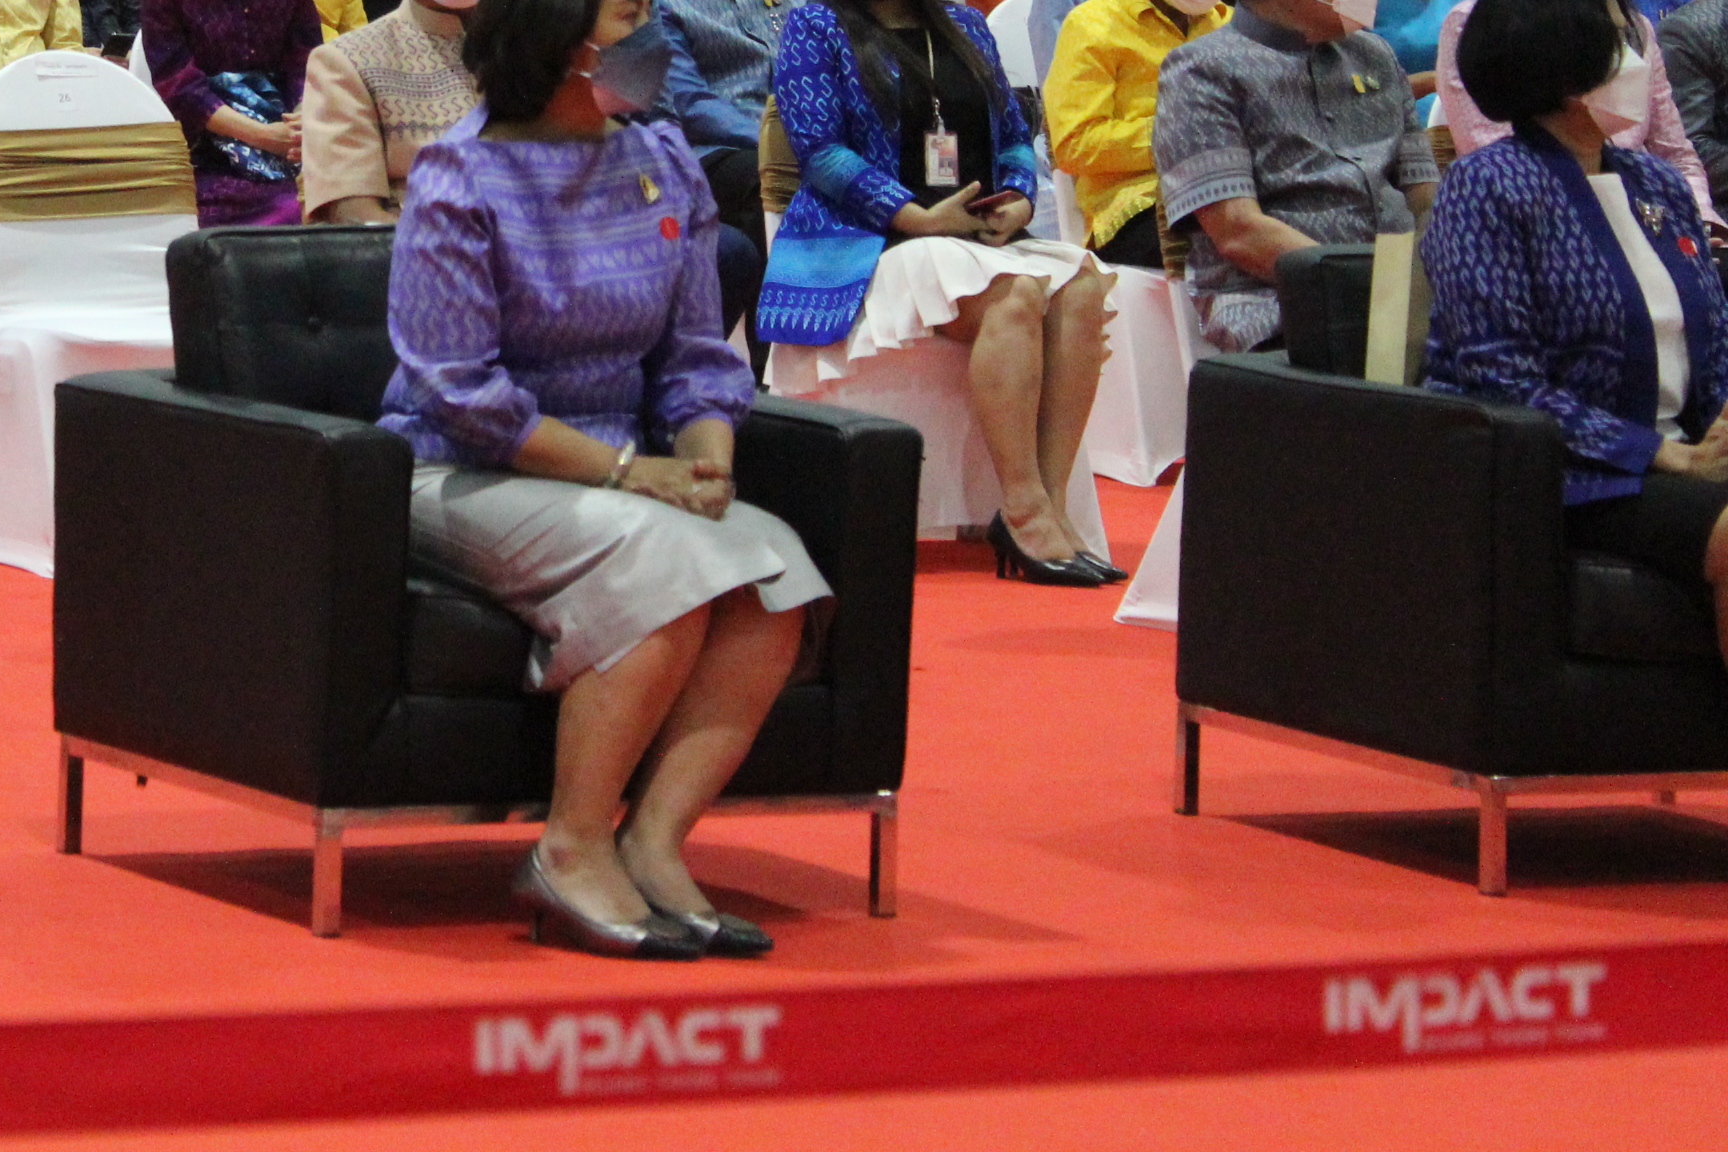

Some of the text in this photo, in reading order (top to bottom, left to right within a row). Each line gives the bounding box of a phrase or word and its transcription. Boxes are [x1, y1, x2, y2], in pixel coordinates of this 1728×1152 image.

[58, 93, 71, 103] 26
[475, 1005, 781, 1097] IMPACT
[1325, 962, 1606, 1054] IMPACT
